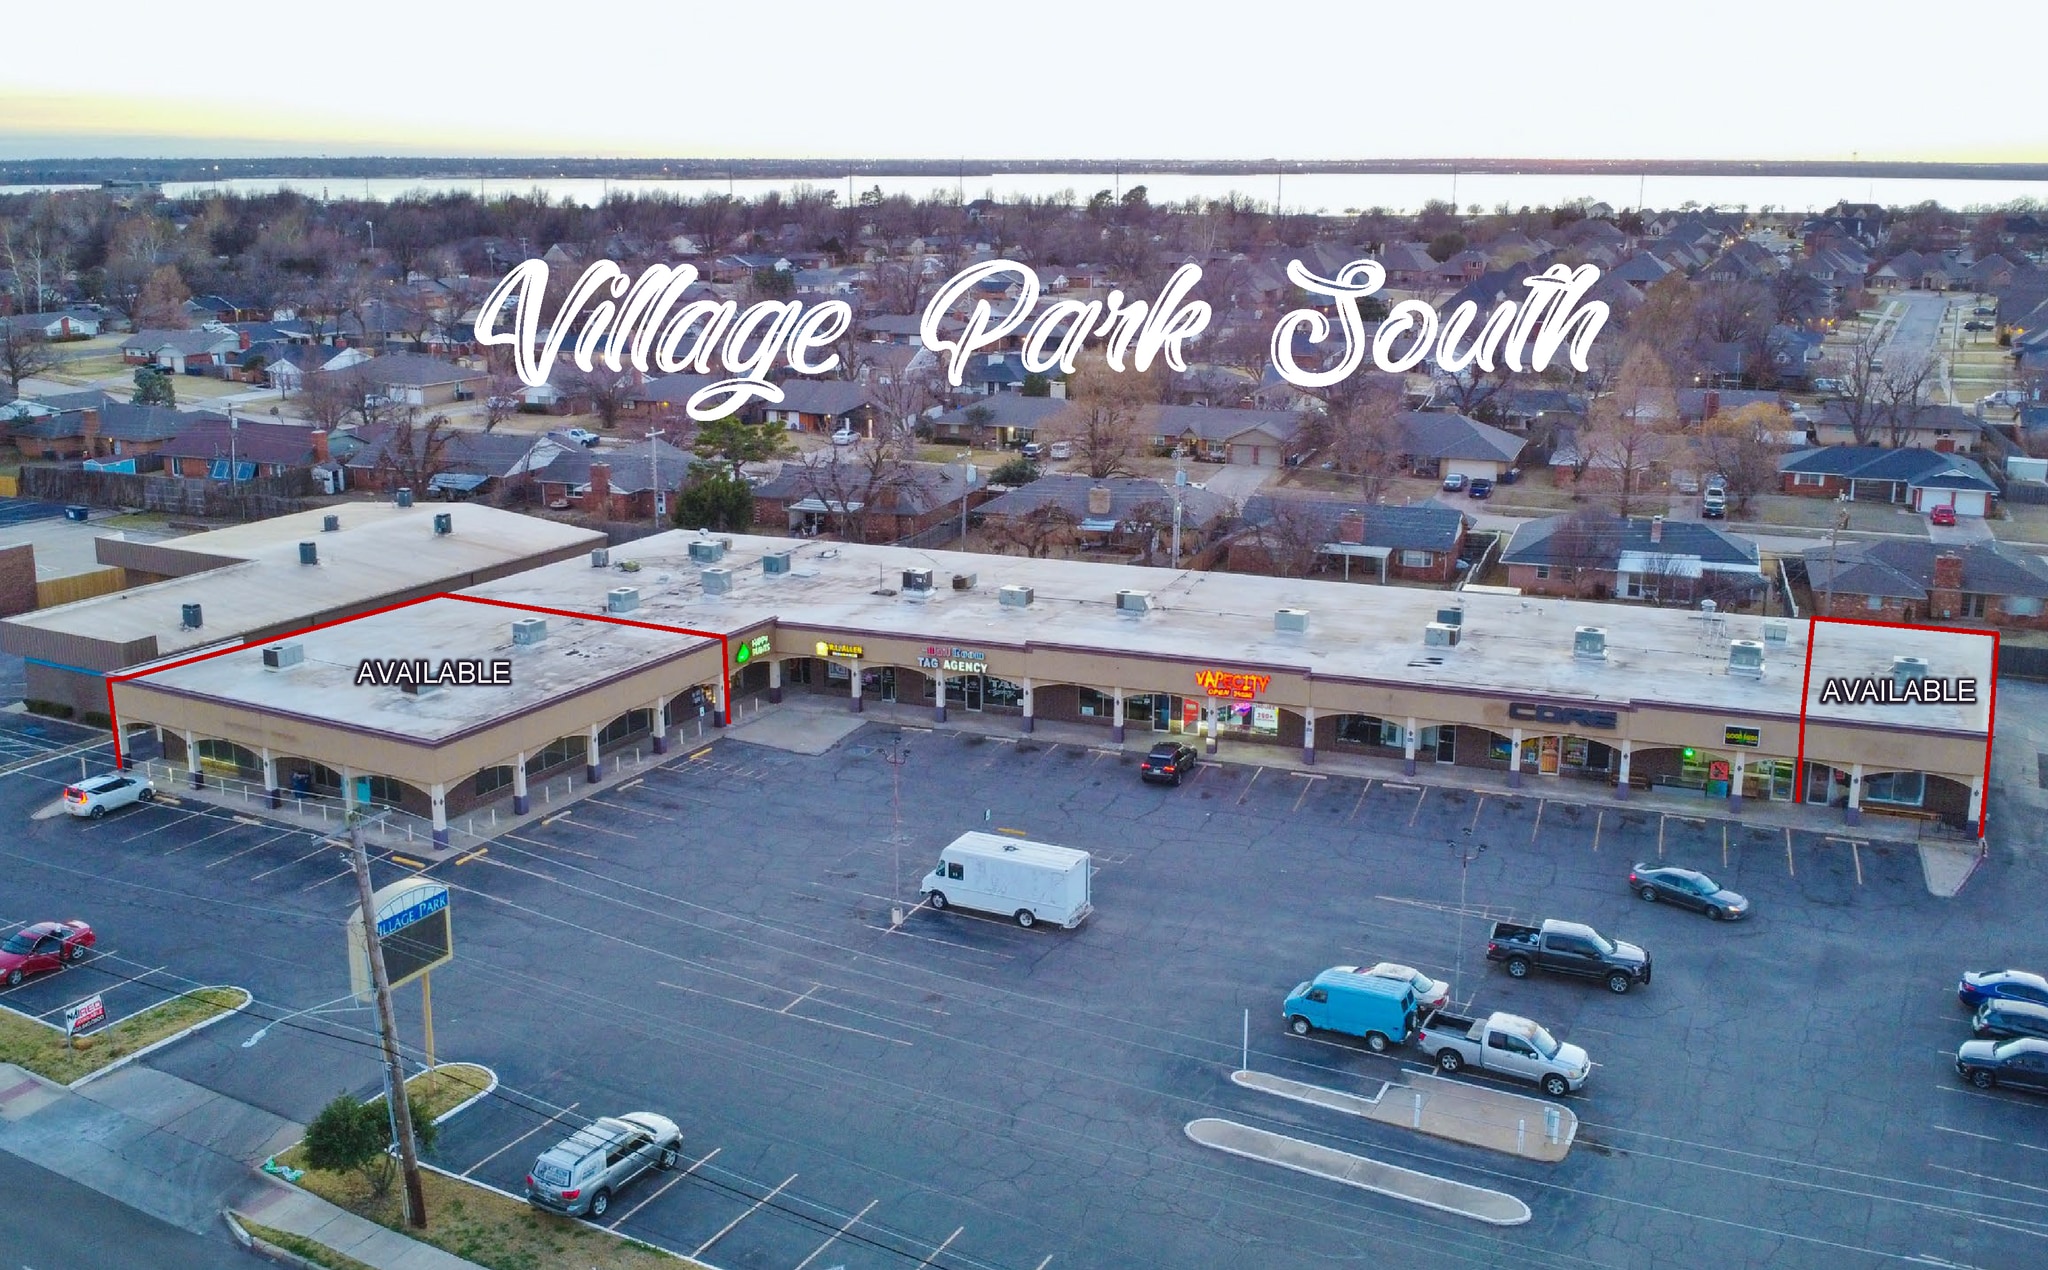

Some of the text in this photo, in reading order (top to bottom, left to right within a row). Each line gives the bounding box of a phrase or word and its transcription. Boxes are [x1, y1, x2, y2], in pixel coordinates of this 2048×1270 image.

[917, 656, 988, 674] TAG AGENCY
[1207, 687, 1231, 697] OPEN
[1509, 702, 1618, 730] CORE
[378, 894, 447, 937] ILLAGE PARK
